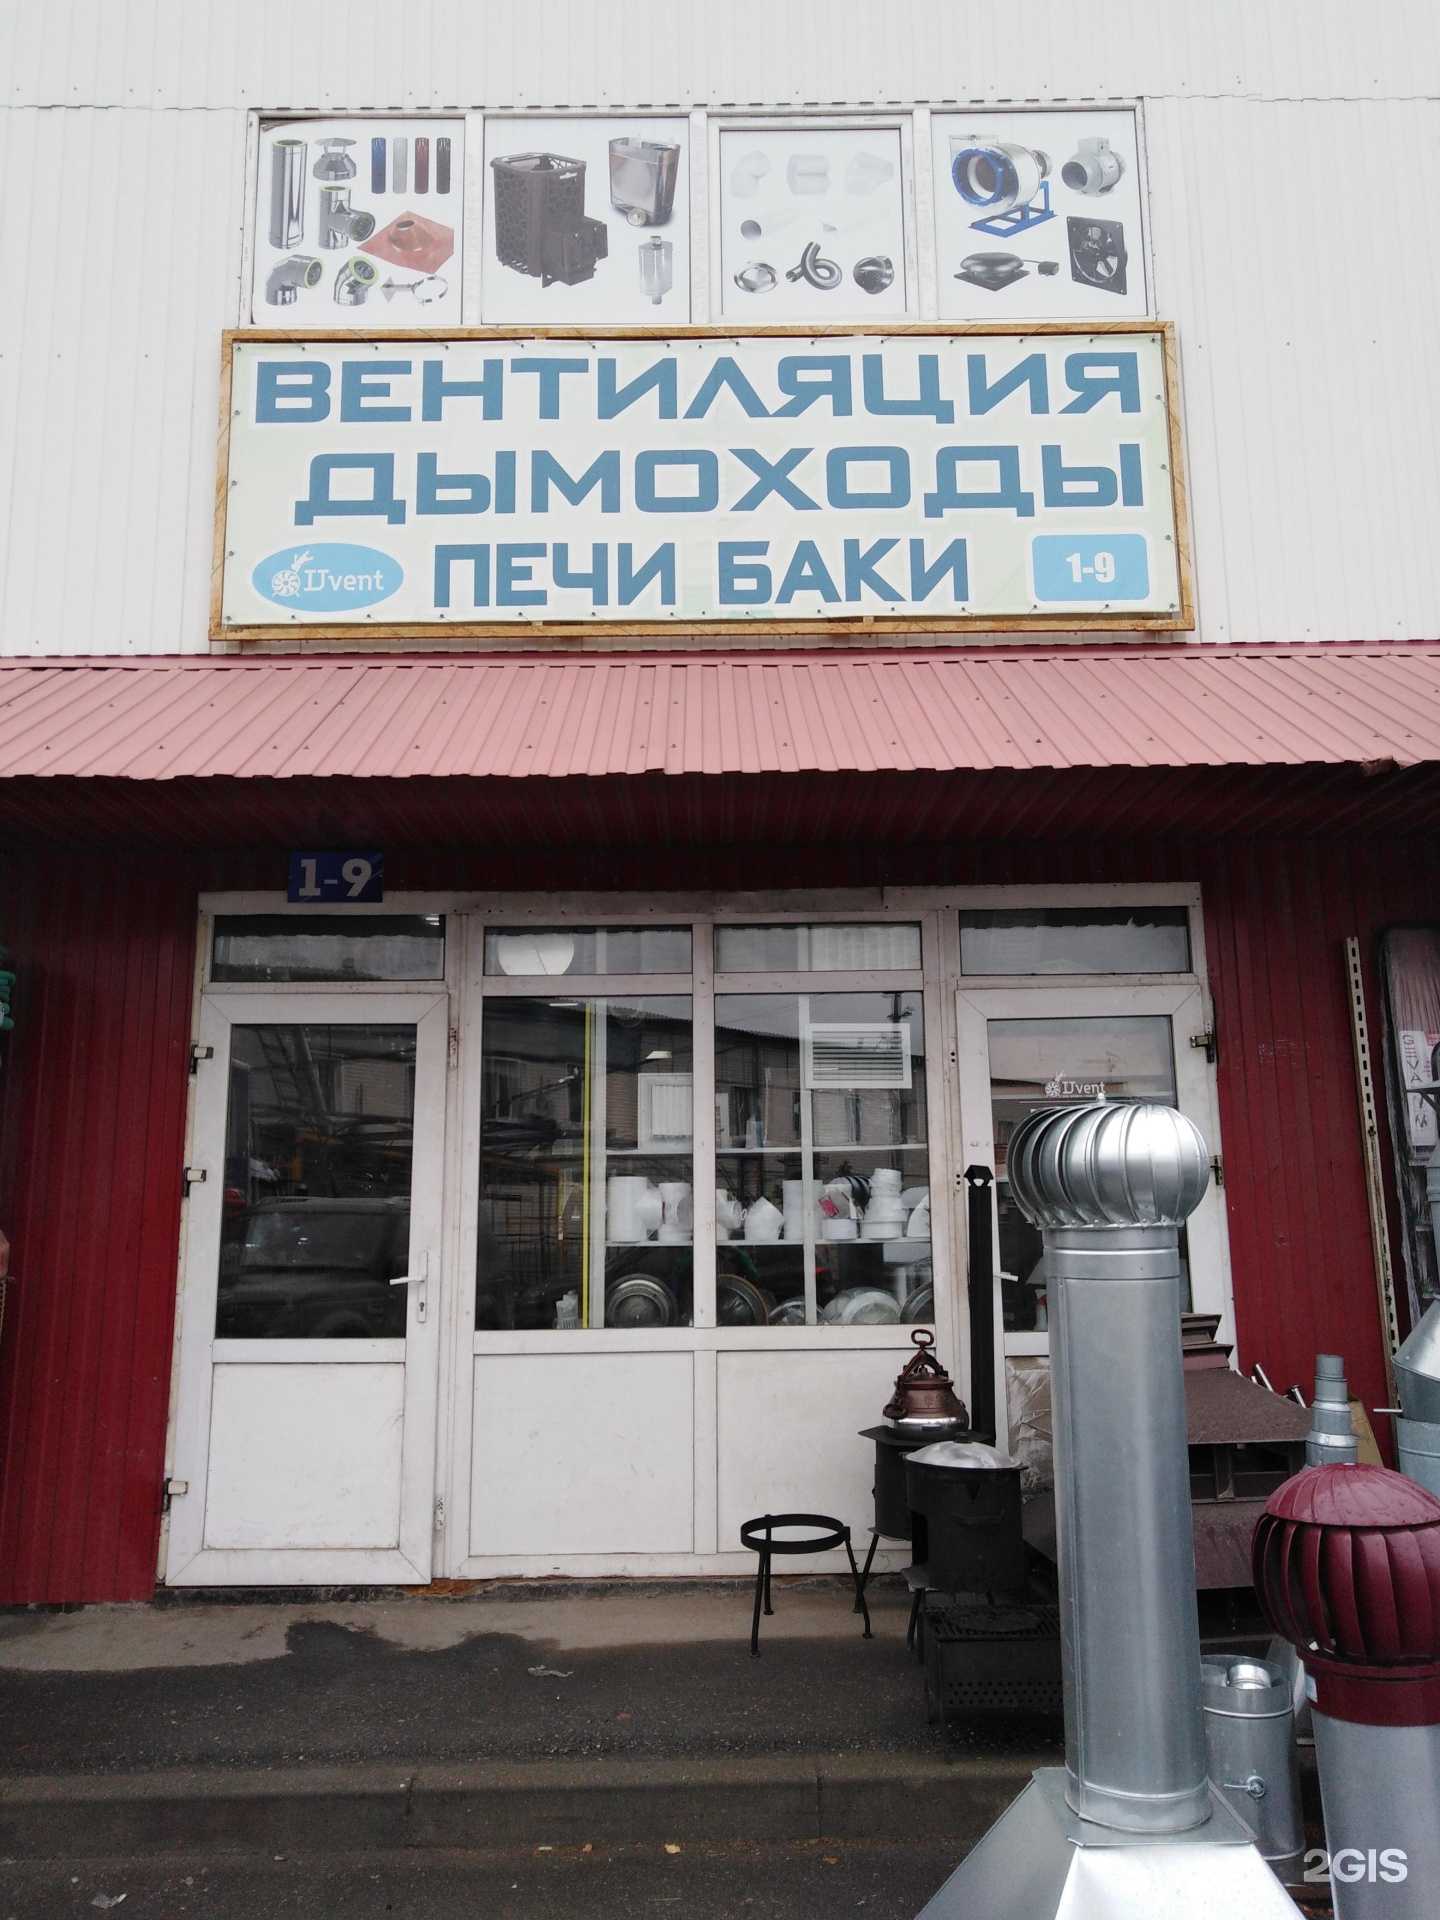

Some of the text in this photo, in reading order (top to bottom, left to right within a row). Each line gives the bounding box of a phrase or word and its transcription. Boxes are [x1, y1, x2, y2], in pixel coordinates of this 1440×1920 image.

[255, 352, 1142, 424] ВЕНТИЛЯЦИЯ
[294, 443, 1144, 526] ДЫМОХОДЫ
[434, 538, 969, 608] ПЕЧИ БАКИ
[1065, 552, 1116, 583] 1-9
[298, 858, 372, 897] 1-9
